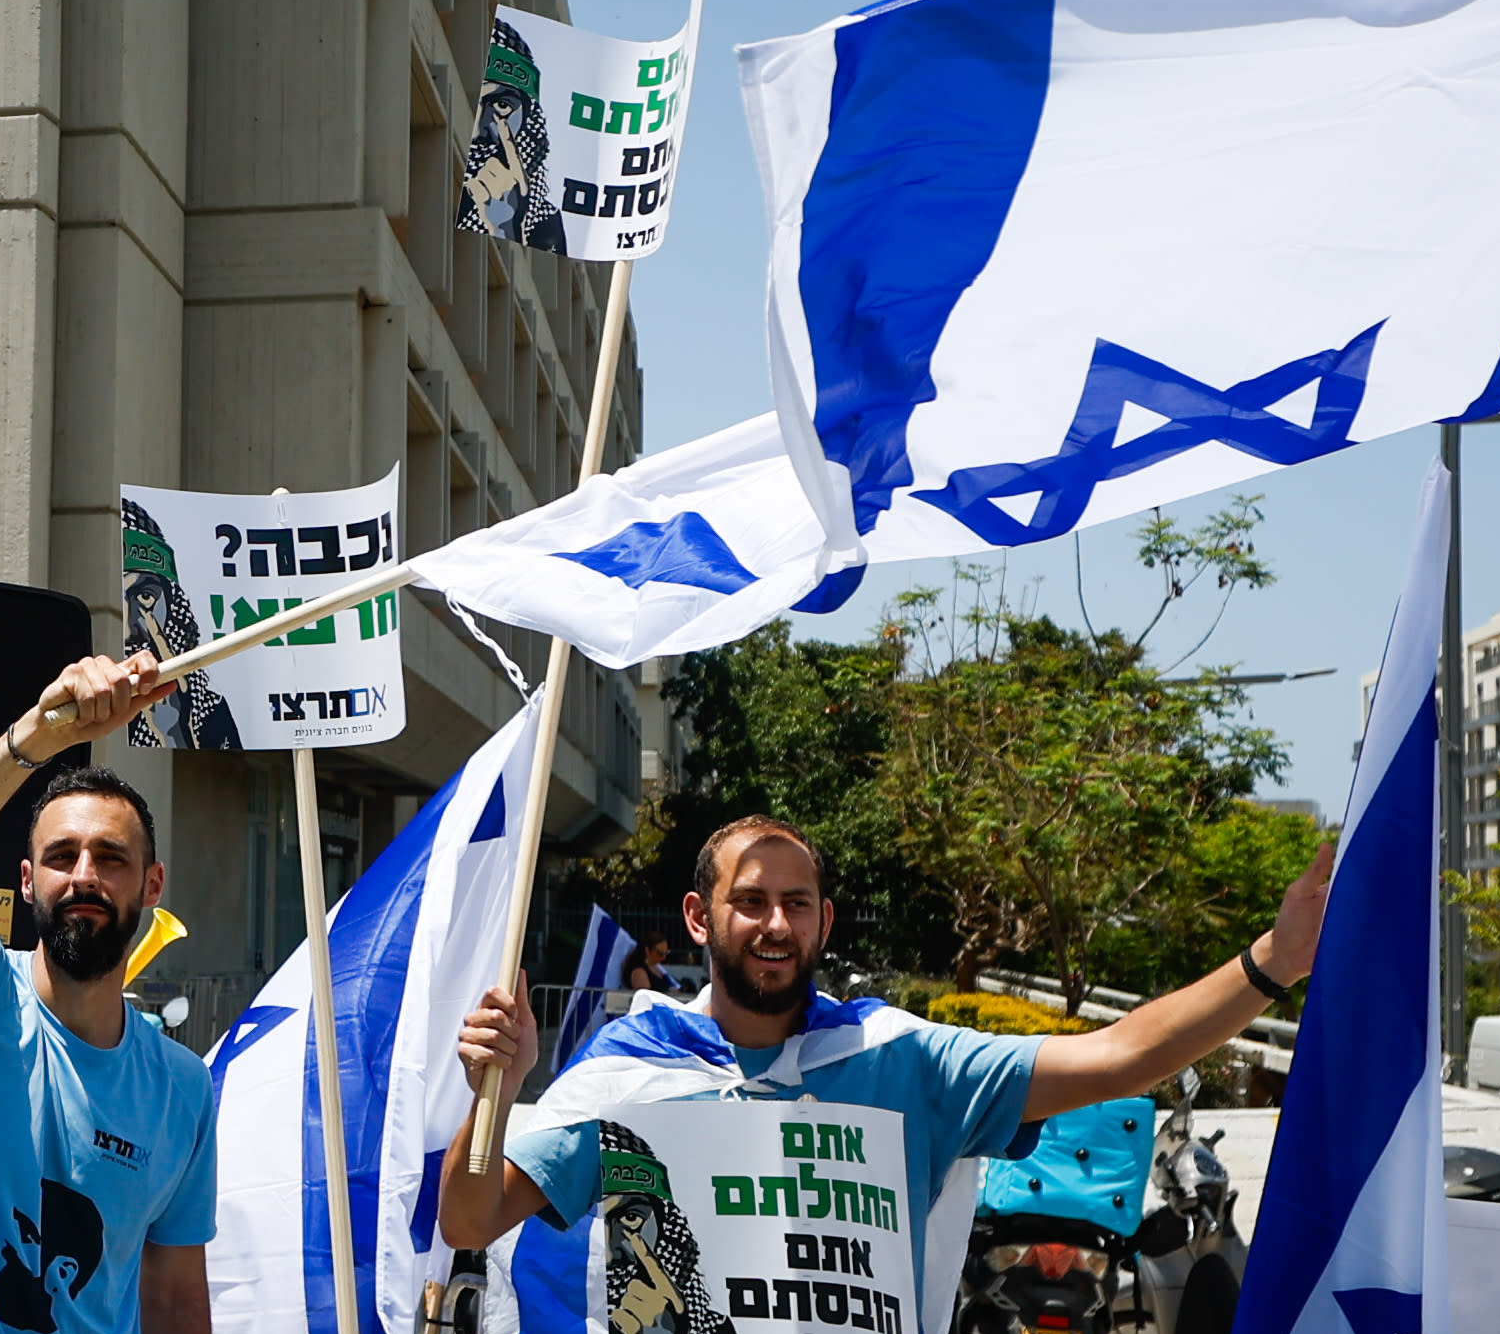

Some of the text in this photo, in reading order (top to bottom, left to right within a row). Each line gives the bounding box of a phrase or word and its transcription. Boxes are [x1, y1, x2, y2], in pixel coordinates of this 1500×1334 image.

[215, 511, 393, 577] נכבה?
[780, 1122, 866, 1165] אתם
[711, 1163, 899, 1234] התחלתם
[784, 1232, 874, 1279] אתם
